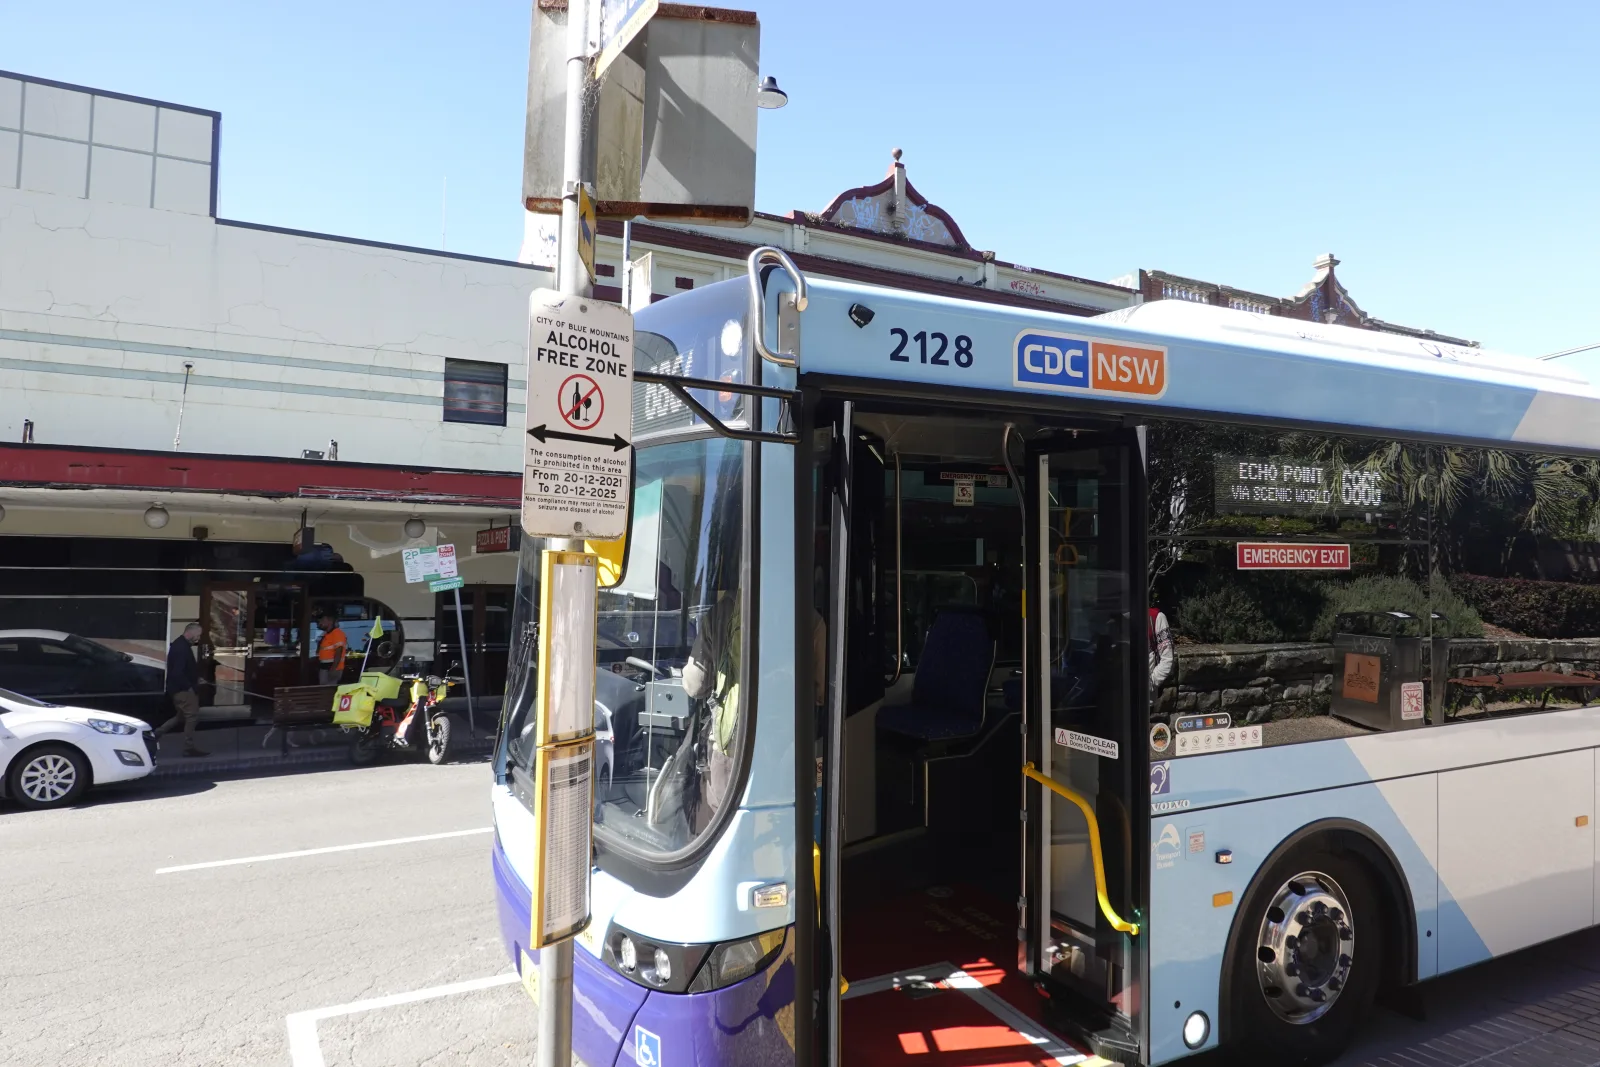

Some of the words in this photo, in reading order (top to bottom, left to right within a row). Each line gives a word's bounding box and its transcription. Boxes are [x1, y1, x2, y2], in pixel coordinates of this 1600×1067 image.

[536, 316, 552, 326] CITY
[568, 323, 587, 333] BLUE
[590, 328, 629, 342] MOUNTAINS
[546, 330, 620, 358] ALCOHOL
[889, 327, 974, 368] 2128
[537, 347, 579, 368] FREE
[586, 357, 627, 378] ZONE
[1024, 344, 1084, 378] CDC
[1097, 352, 1158, 386] NSW
[530, 448, 543, 456] The
[546, 450, 592, 462] consumption
[603, 458, 626, 466] alcohol
[544, 459, 580, 469] prohibited
[532, 470, 559, 481] From
[564, 473, 622, 487] 20-12-2021
[1239, 462, 1278, 481] ECHO
[1284, 465, 1324, 484] POINT
[538, 483, 549, 493] To
[554, 484, 616, 499] 20-12-2025
[1232, 485, 1250, 500] VIA
[1253, 486, 1292, 502] SCENIC
[1295, 489, 1330, 504] WORLD
[537, 497, 566, 505] compliance
[404, 550, 418, 560] 2P
[1244, 548, 1318, 564] EMERGENCY
[1320, 550, 1344, 564] EXIT
[1178, 720, 1193, 729] opal
[1070, 733, 1091, 744] STAND
[1093, 739, 1116, 750] CLEAR
[1070, 740, 1083, 748] Doors
[1151, 799, 1190, 812] VOLVO
[1156, 851, 1181, 861] Transport
